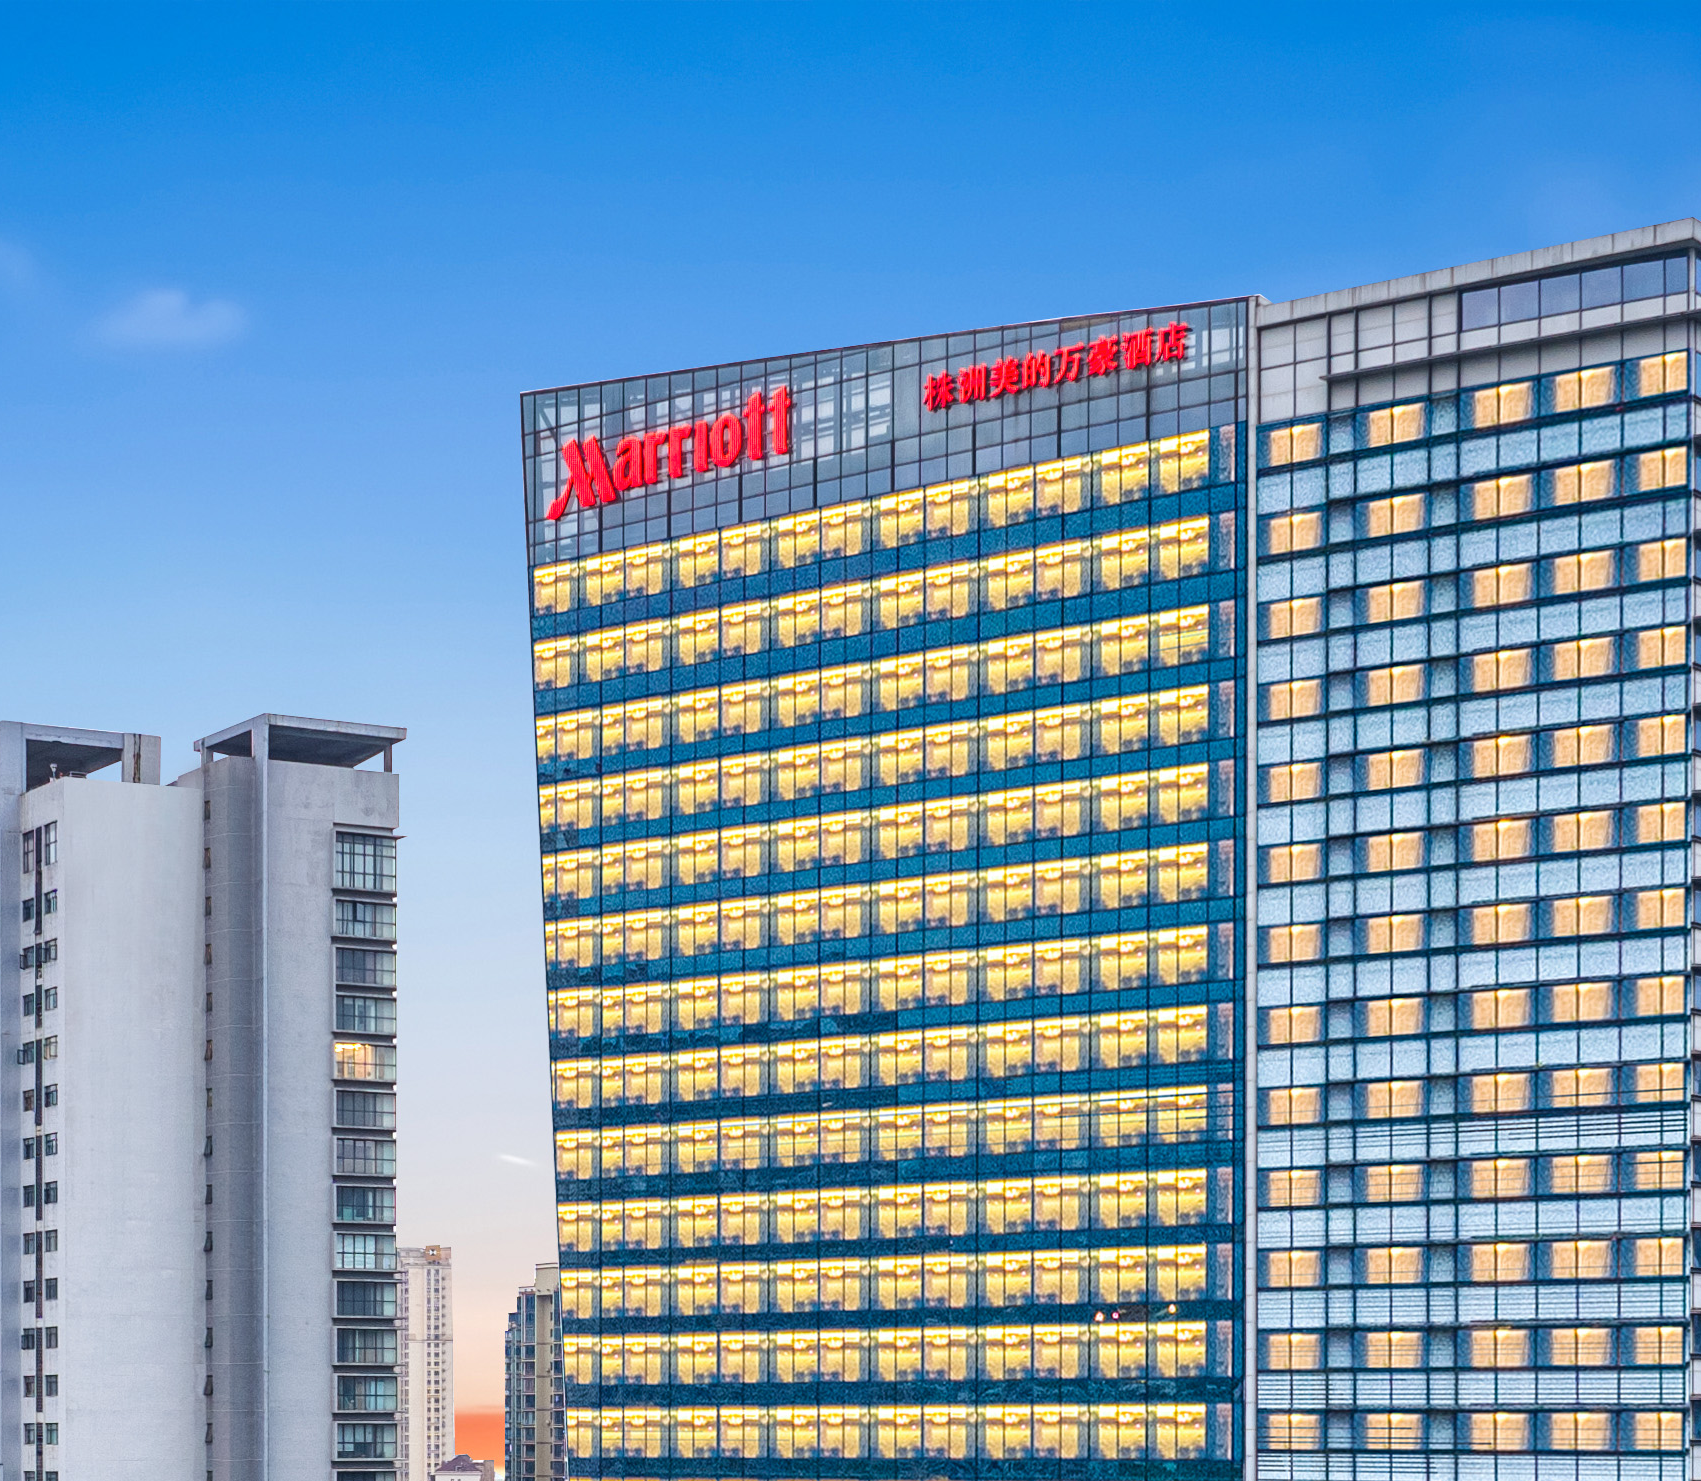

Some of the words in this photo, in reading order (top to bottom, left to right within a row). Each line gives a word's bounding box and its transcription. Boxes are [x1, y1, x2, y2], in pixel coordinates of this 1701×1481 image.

[923, 321, 1188, 411] 株洲美的万豪酒店
[546, 385, 791, 520] Marriott
